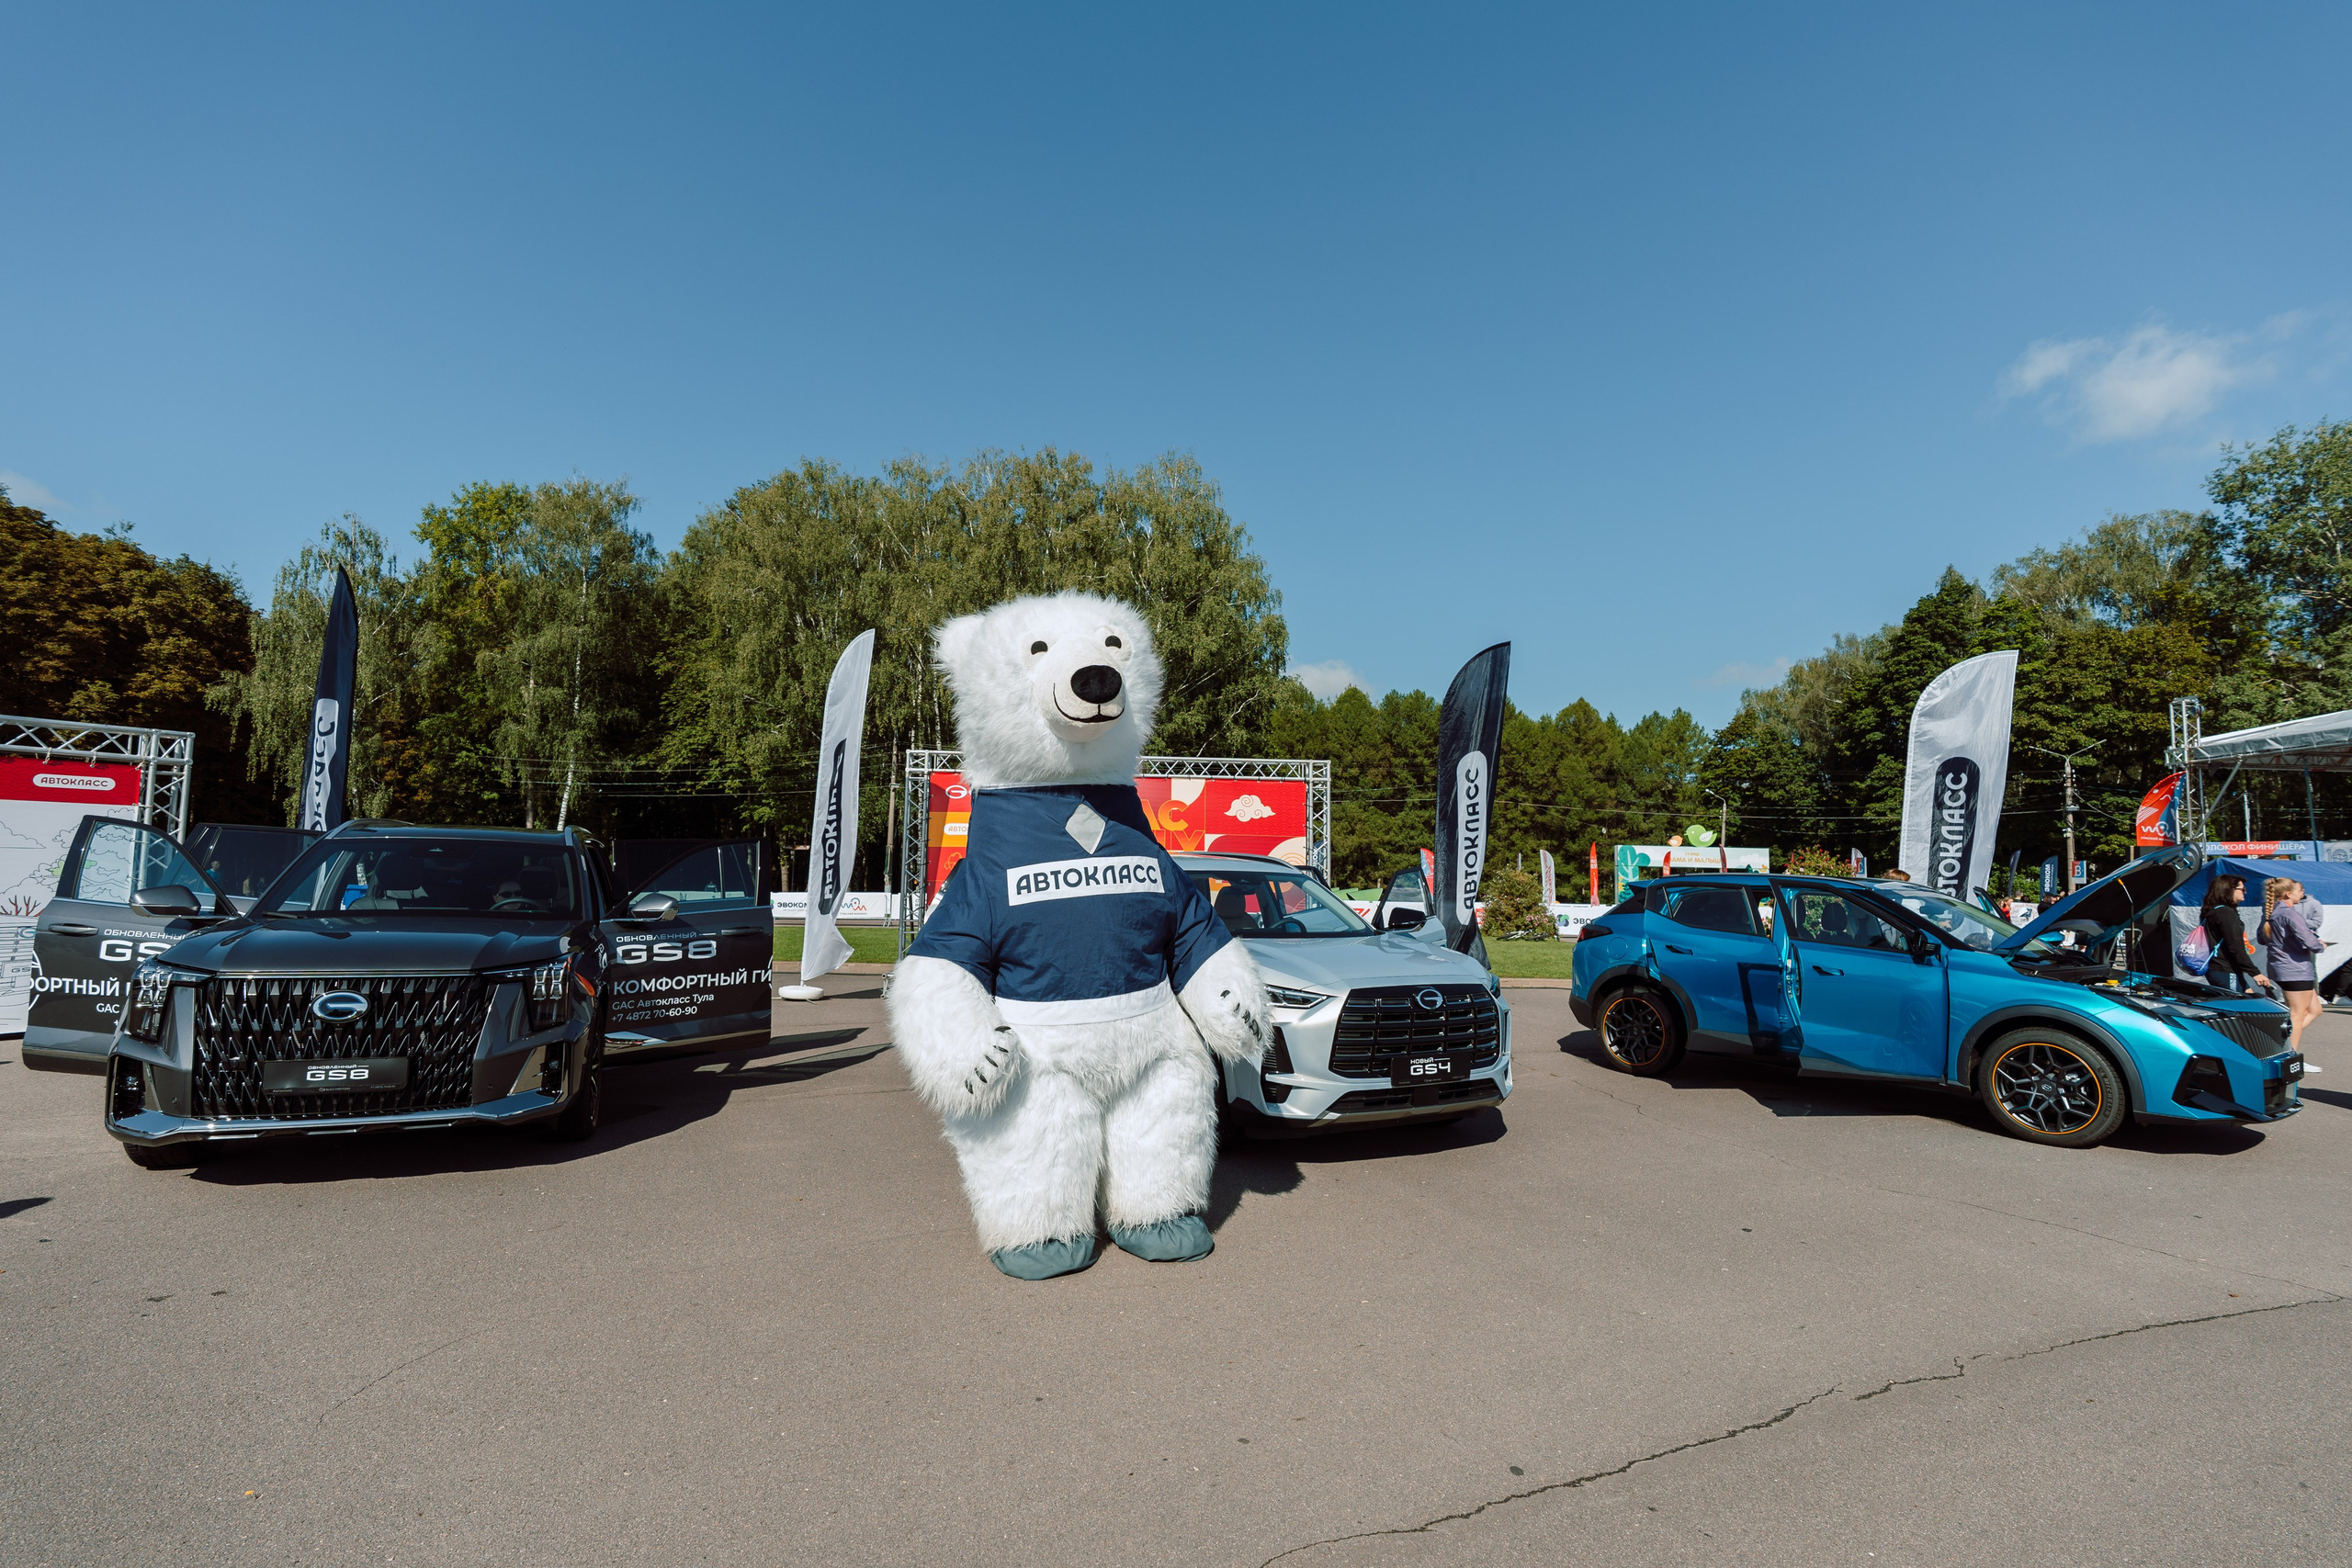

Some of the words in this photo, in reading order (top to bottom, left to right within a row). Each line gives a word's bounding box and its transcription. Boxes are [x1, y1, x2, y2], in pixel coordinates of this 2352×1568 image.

[40, 777, 108, 787] АВТОКЛАСС
[1463, 766, 1480, 910] АВТОКЛАСС
[1016, 864, 1158, 896] АВТОКЛАСС
[104, 929, 186, 940] ОБНОВЛЕННЫ
[616, 931, 697, 942] ОБНОВЛЕННЫЙ
[99, 939, 172, 962] GS
[616, 940, 717, 964] GS8
[30, 976, 119, 997] ОРТНЫЙ
[614, 968, 747, 996] КОМФОРТНЫЙ
[96, 1002, 120, 1013] GAC
[612, 999, 635, 1010] GAC
[637, 995, 691, 1008] Автокласс
[692, 993, 714, 1004] Тула
[611, 1014, 624, 1022] +7
[626, 1010, 651, 1021] 4872
[653, 1006, 698, 1019] 70-60-90
[306, 1068, 369, 1081] GS8
[1410, 1062, 1451, 1076] GS4
